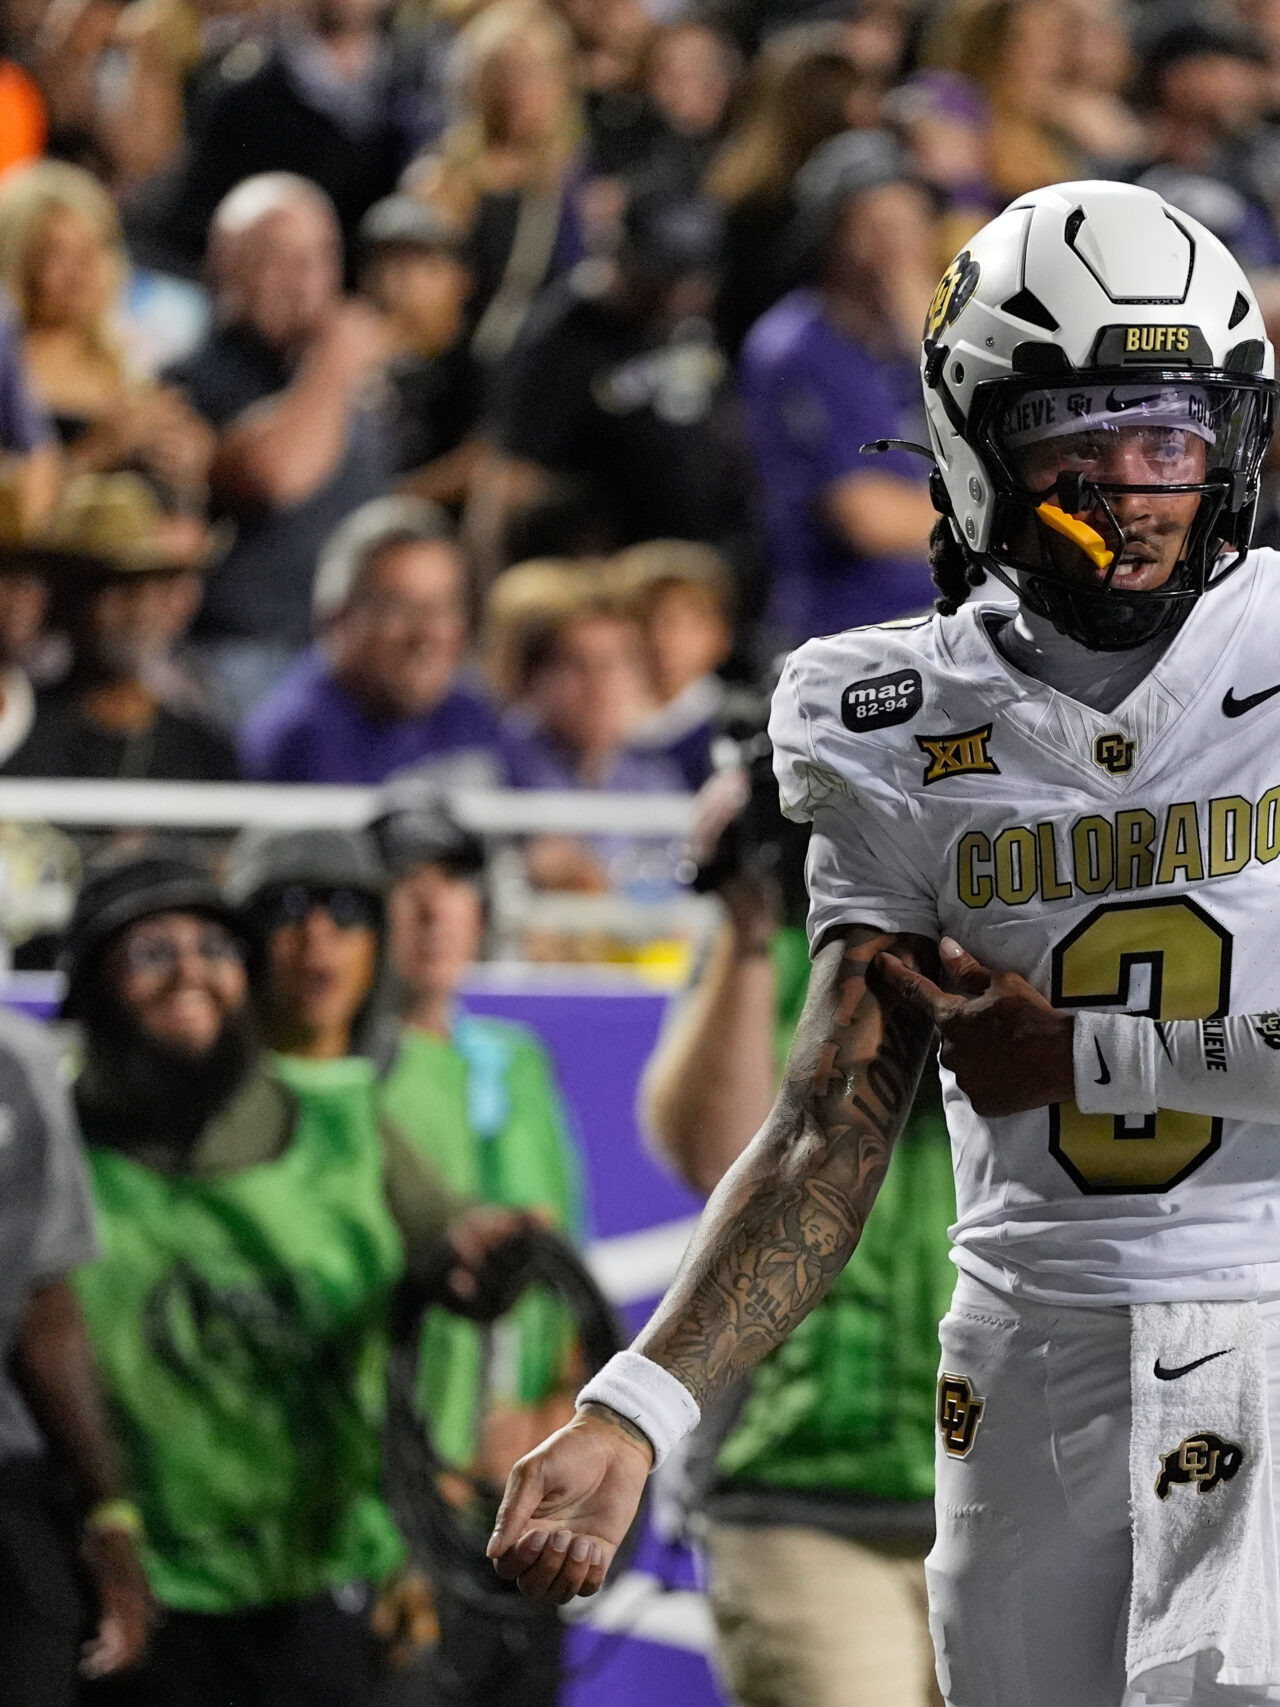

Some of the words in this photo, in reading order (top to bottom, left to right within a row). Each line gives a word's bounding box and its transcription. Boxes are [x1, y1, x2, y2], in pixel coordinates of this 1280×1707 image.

[1126, 327, 1189, 352] BUFFS
[1189, 394, 1215, 432] COLO
[848, 678, 915, 704] mac
[855, 697, 908, 719] 82-94
[919, 728, 997, 783] XII
[1048, 894, 1233, 1195] 3
[1202, 1018, 1227, 1072] ELIEVE
